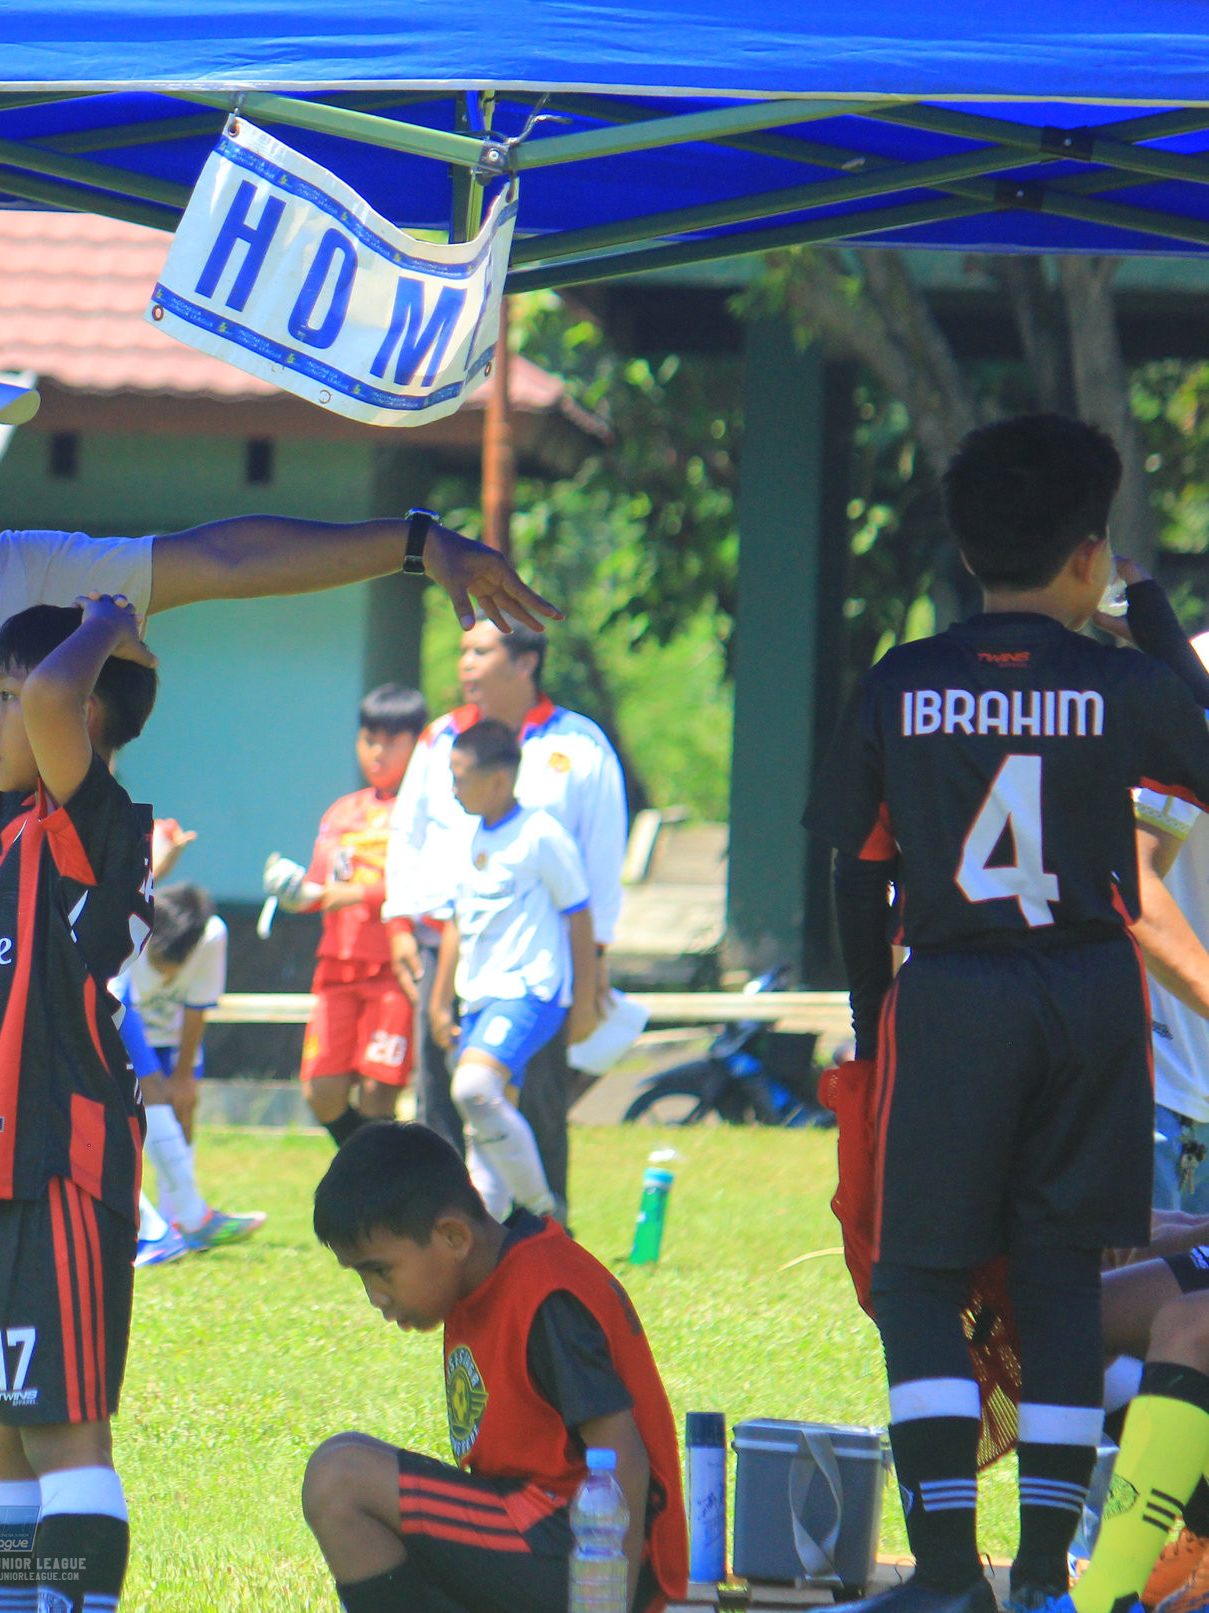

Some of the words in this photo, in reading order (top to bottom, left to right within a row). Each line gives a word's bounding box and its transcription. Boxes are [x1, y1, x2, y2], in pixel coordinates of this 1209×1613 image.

[195, 180, 490, 388] HOM
[903, 689, 1104, 737] IBRAHIM
[954, 753, 1060, 928] 4
